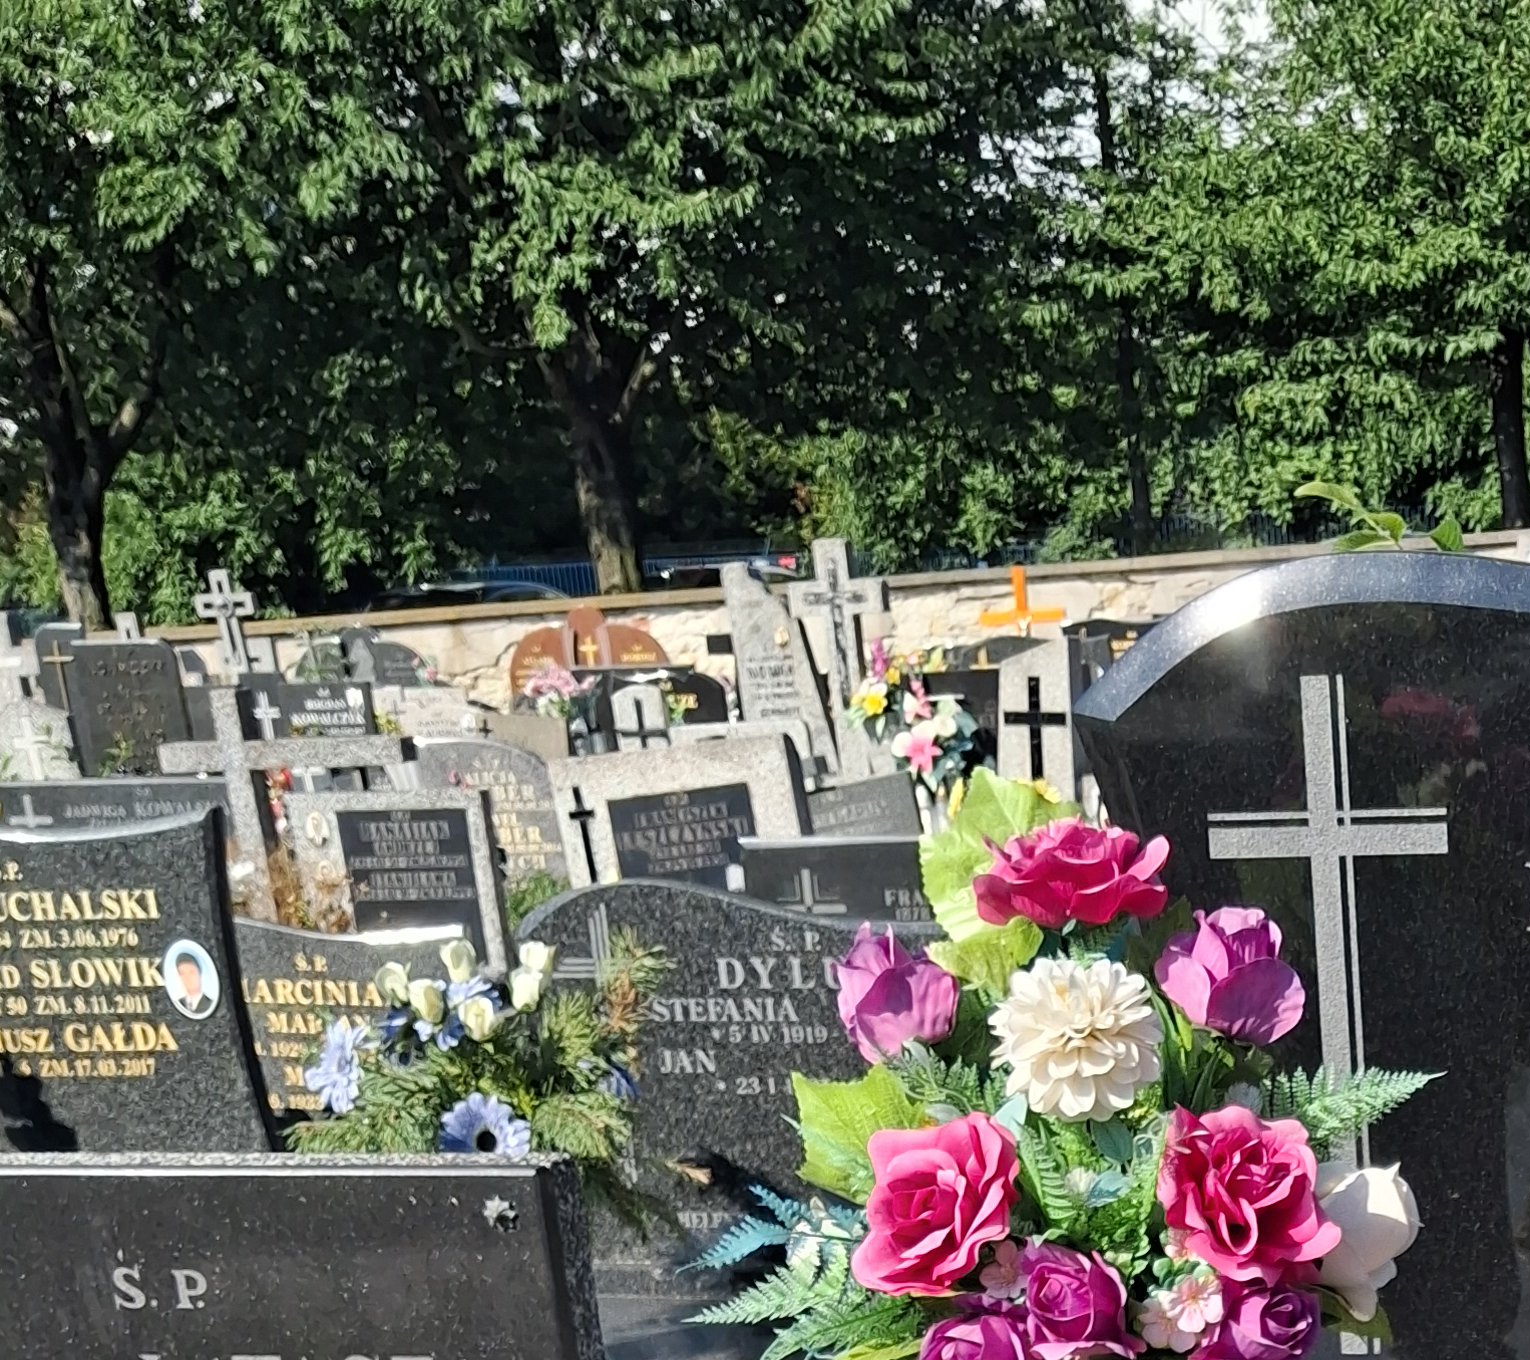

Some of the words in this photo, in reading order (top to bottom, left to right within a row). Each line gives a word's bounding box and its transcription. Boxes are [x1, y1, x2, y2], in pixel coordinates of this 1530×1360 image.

[29, 954, 165, 989] SŁOWIK
[242, 977, 391, 1008] ARCINIA
[650, 998, 800, 1022] STEFANIA
[63, 1022, 180, 1053] GAŁDA
[658, 1049, 717, 1074] JAN
[171, 1268, 209, 1310] P.
